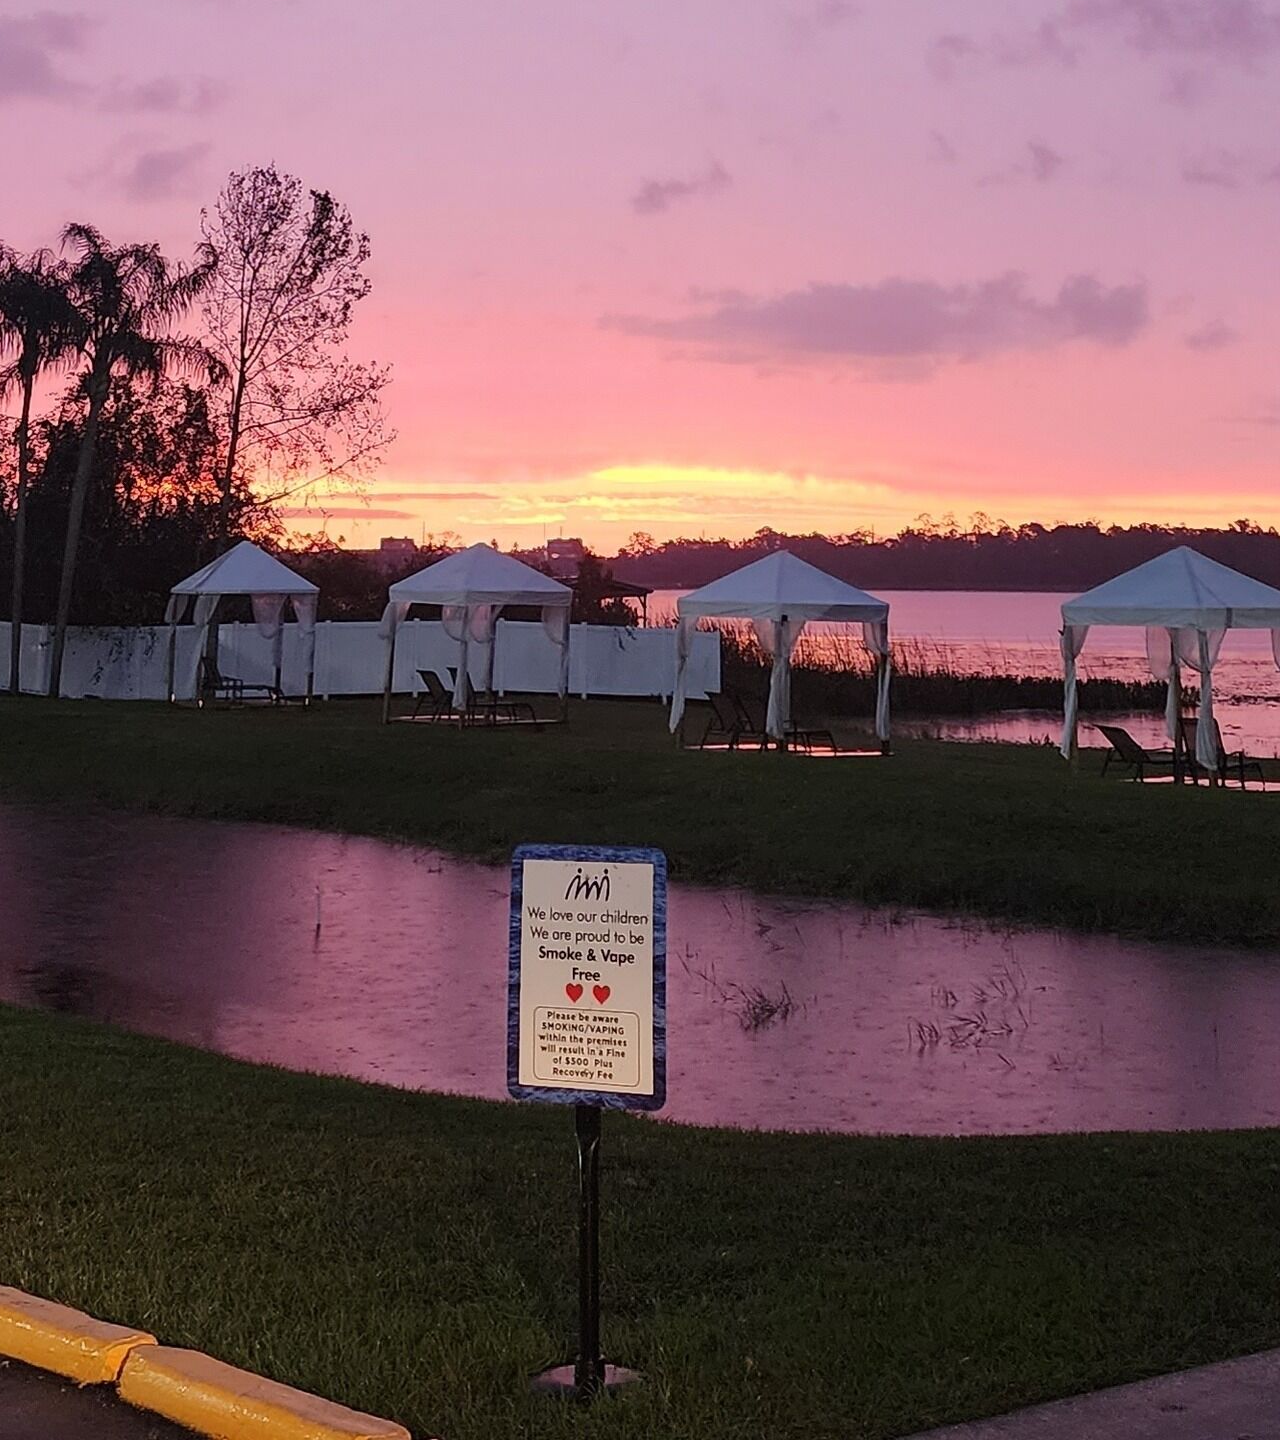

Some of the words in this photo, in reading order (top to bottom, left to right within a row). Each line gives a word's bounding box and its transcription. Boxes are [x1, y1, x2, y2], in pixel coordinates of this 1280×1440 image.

[527, 907, 546, 920] We
[550, 908, 573, 921] love
[577, 913, 597, 923] our
[600, 909, 648, 925] children
[530, 926, 549, 939] We
[552, 931, 571, 940] are
[575, 929, 610, 944] proud
[614, 934, 625, 943] to
[630, 931, 644, 944] be
[539, 946, 582, 960] Smoke
[587, 949, 597, 961] &
[601, 949, 635, 966] Vape
[572, 968, 600, 981] Free
[547, 1011, 576, 1020] Please
[579, 1013, 589, 1021] be
[542, 1022, 625, 1035] SMOKING/VAPING
[539, 1033, 566, 1041] within
[570, 1035, 583, 1043] the
[587, 1036, 627, 1046] premises
[559, 1046, 584, 1054] result
[606, 1049, 625, 1057] Fine
[553, 1056, 562, 1064] of
[565, 1057, 588, 1066] $500
[594, 1059, 612, 1068] Plus
[553, 1067, 594, 1079] Recovery
[597, 1071, 613, 1079] Fee
